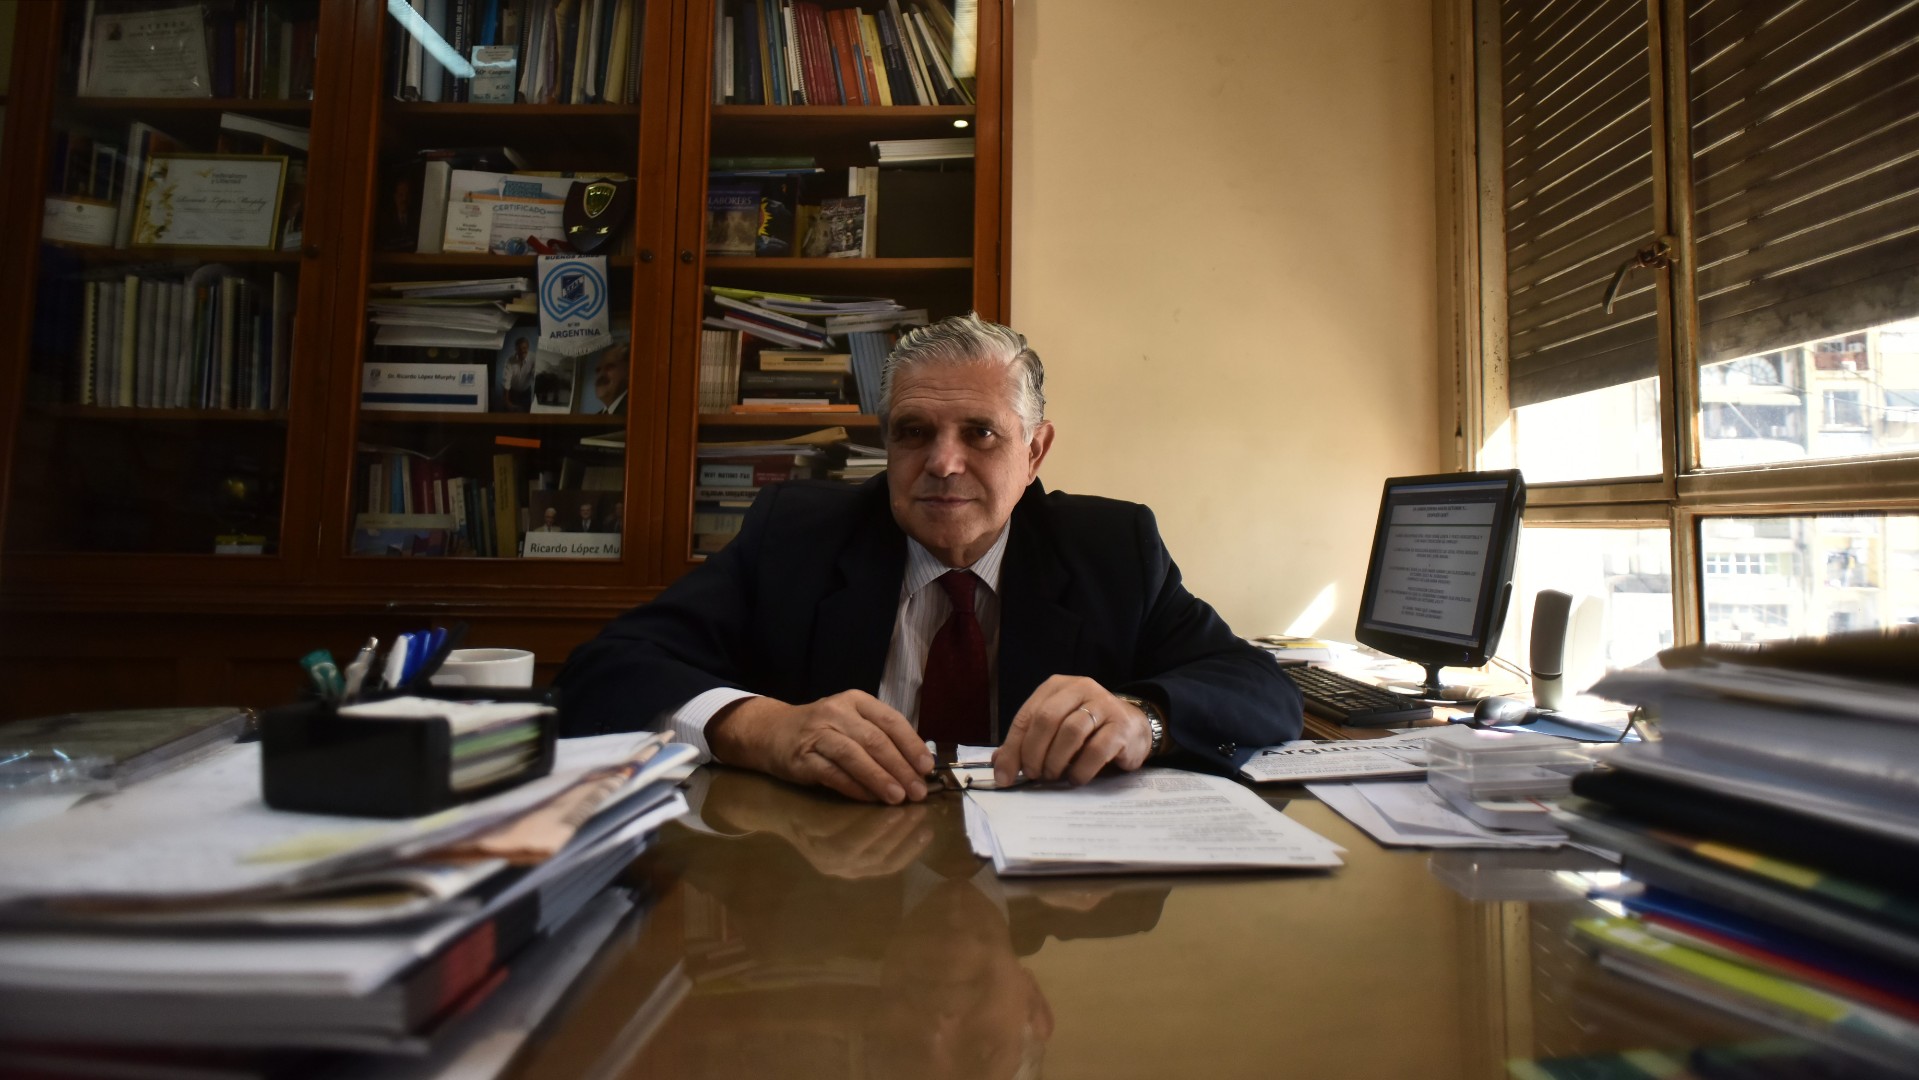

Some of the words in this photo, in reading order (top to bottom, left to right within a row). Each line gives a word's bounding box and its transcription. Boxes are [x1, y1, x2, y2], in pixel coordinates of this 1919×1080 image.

[492, 203, 547, 215] CERTIFICADO
[549, 328, 600, 339] ARGENTINA
[418, 373, 433, 381] López
[434, 373, 456, 381] Murphy
[529, 542, 568, 553] Ricardo
[571, 542, 600, 556] López
